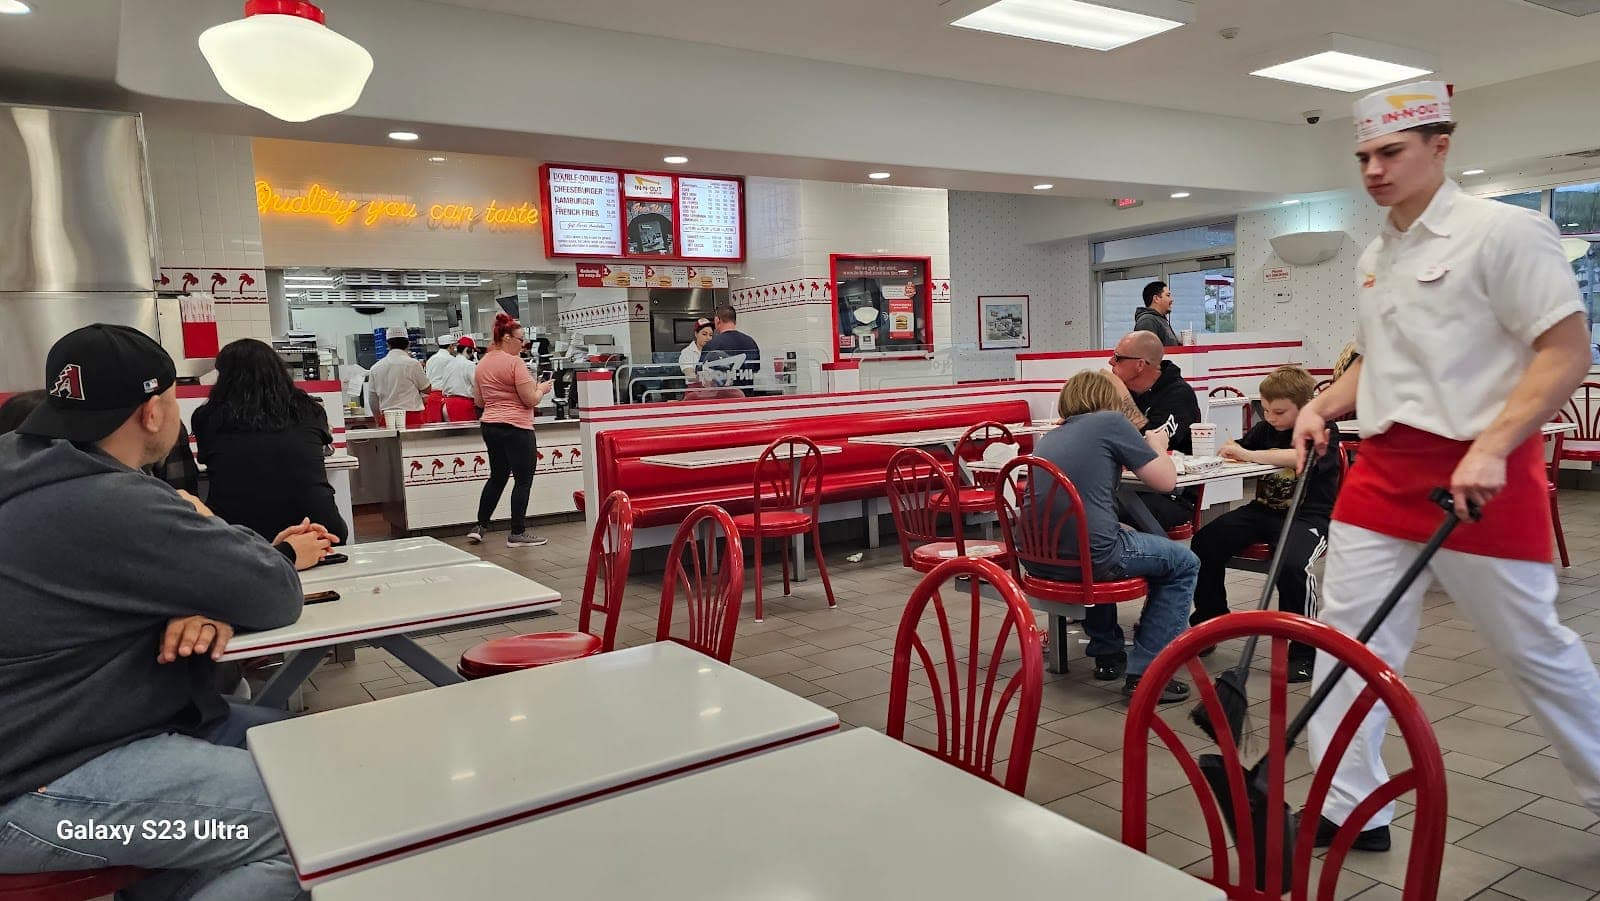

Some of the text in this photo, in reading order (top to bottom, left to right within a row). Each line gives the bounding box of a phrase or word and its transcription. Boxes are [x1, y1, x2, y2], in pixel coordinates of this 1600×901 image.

[553, 172, 604, 182] DOUBLE-DOUBLE
[554, 185, 603, 195] CHEESEBURGER
[255, 181, 539, 225] Quality you can taste
[554, 197, 595, 206] HAMBURGER
[555, 208, 580, 216] FRENCH
[581, 209, 600, 217] FRIES
